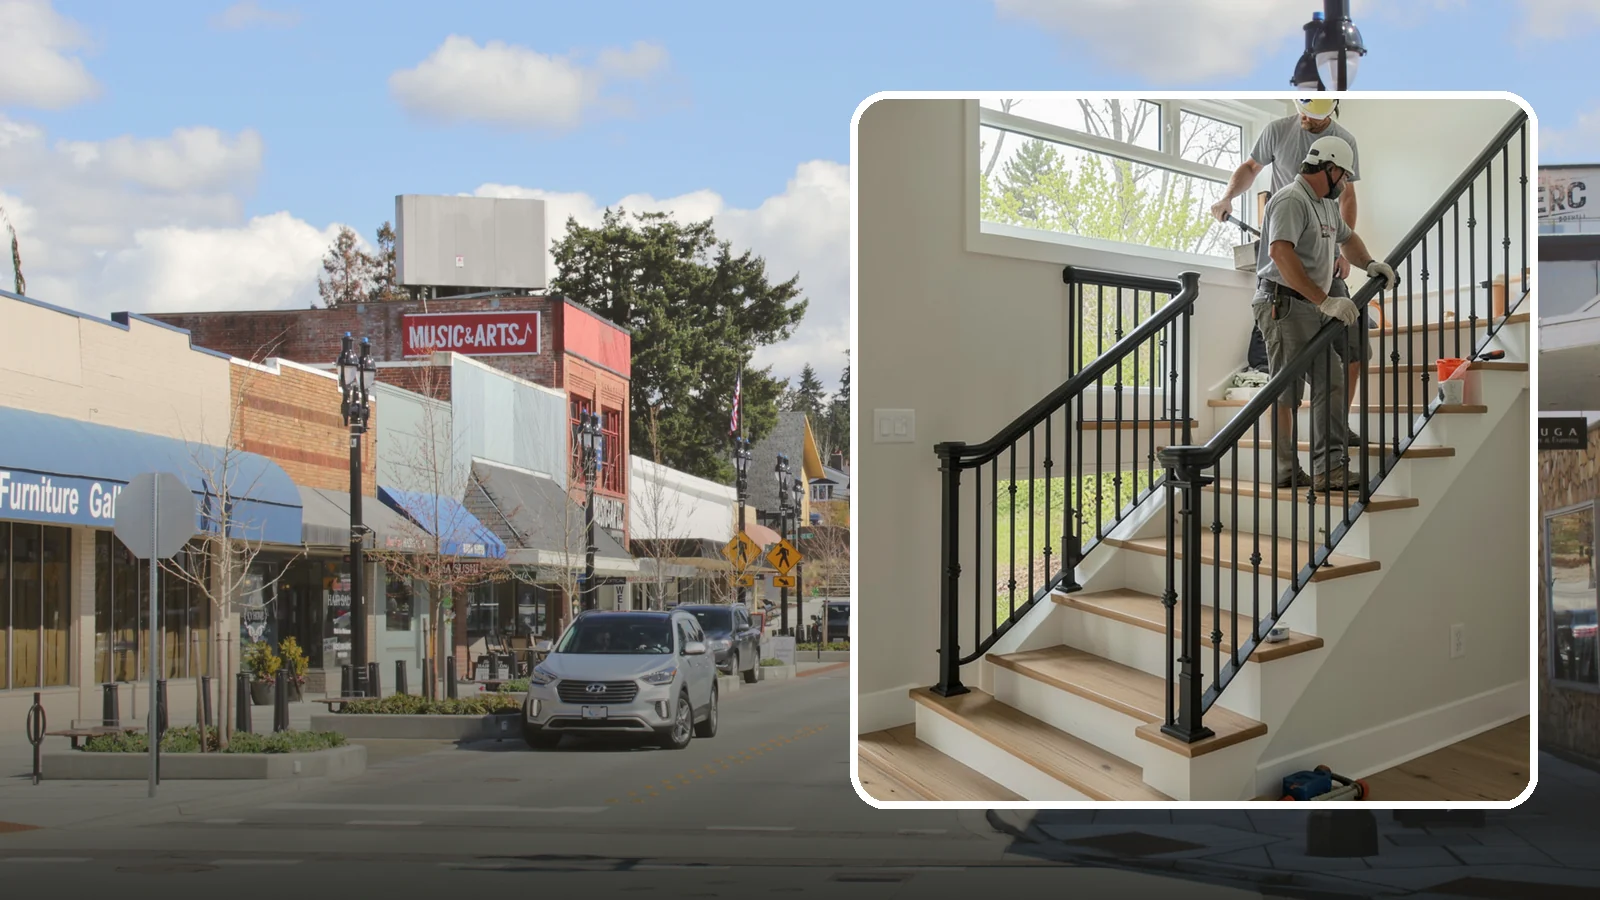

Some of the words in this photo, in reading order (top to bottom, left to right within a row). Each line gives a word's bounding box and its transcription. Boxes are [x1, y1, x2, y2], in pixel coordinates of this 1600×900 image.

[0, 471, 79, 515] Furniture
[89, 482, 122, 519] Gal
[453, 563, 480, 575] SUSHI
